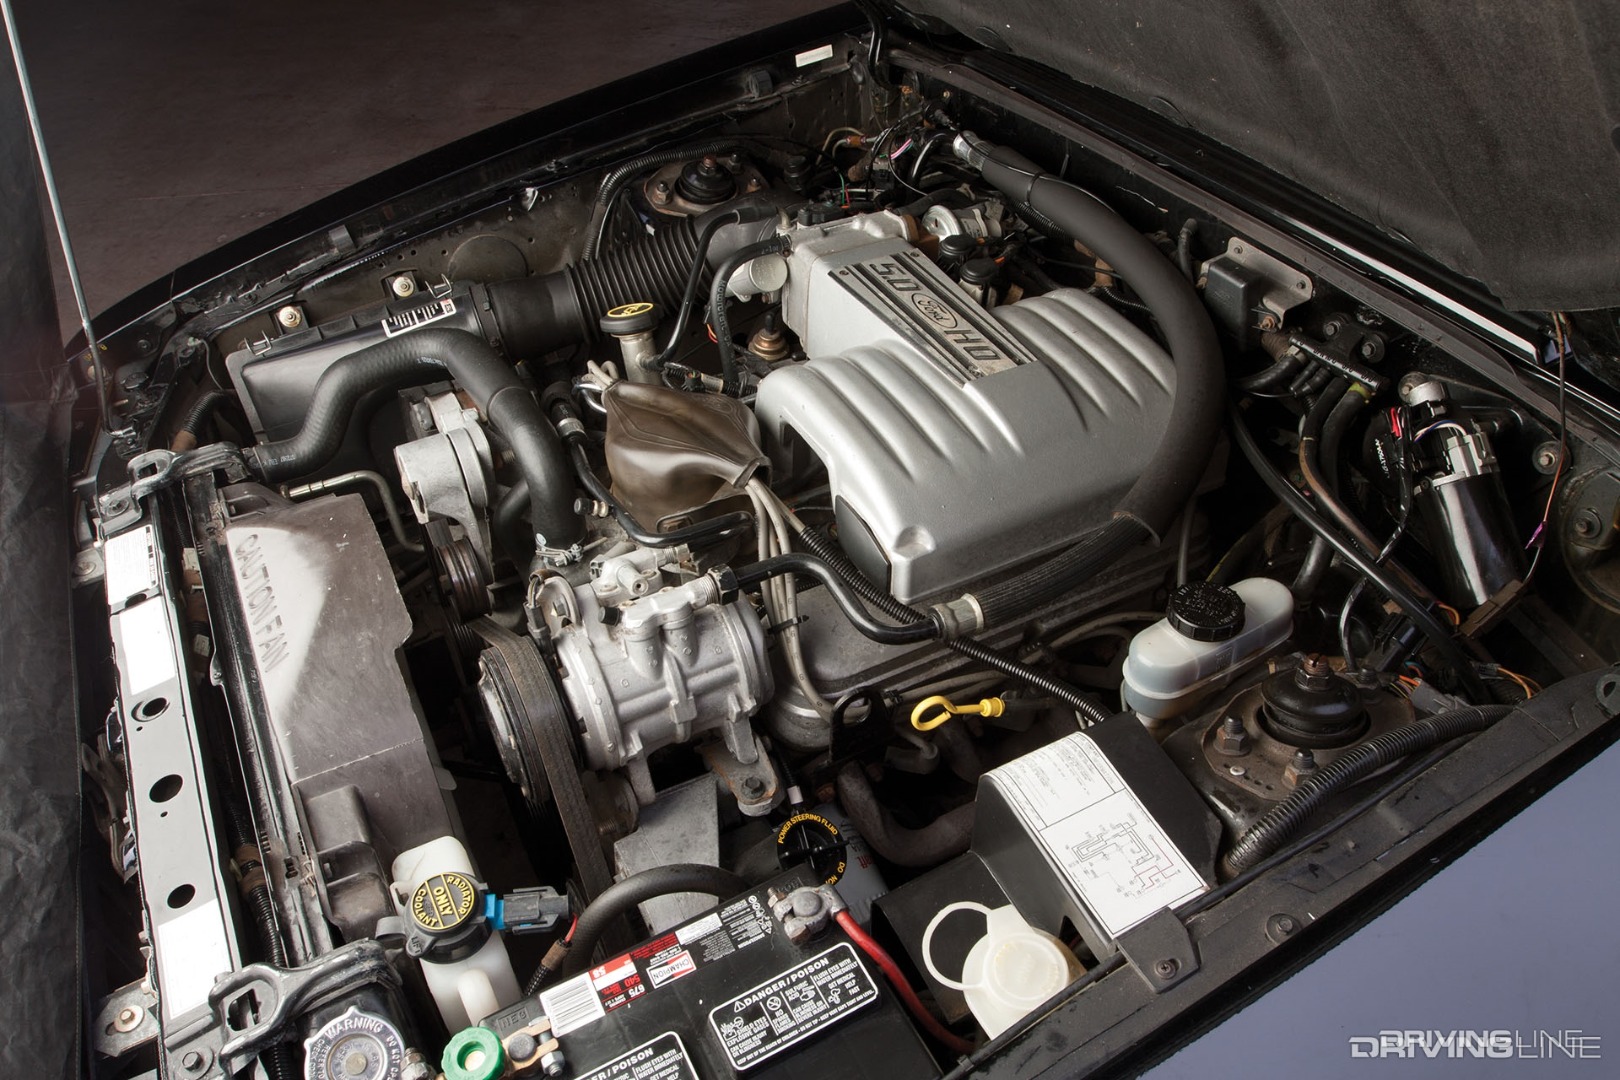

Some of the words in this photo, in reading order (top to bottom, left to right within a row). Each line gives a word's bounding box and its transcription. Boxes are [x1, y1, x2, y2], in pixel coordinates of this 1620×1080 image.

[870, 263, 922, 291] 5.0
[235, 534, 277, 626] CAUTION
[255, 614, 290, 673] FAN
[778, 820, 793, 844] POWER
[790, 813, 821, 825] STEERING
[821, 818, 838, 835] FLUID
[837, 861, 846, 873] DO
[414, 888, 438, 927] COOLANT
[433, 886, 453, 916] ONLY
[447, 876, 470, 915] RADIATOR
[653, 958, 690, 980] CHAMPION
[628, 984, 645, 998] 675
[845, 980, 857, 989] HELP
[849, 986, 860, 995] FAST
[775, 1009, 784, 1017] NO
[324, 1017, 384, 1039] WARNING
